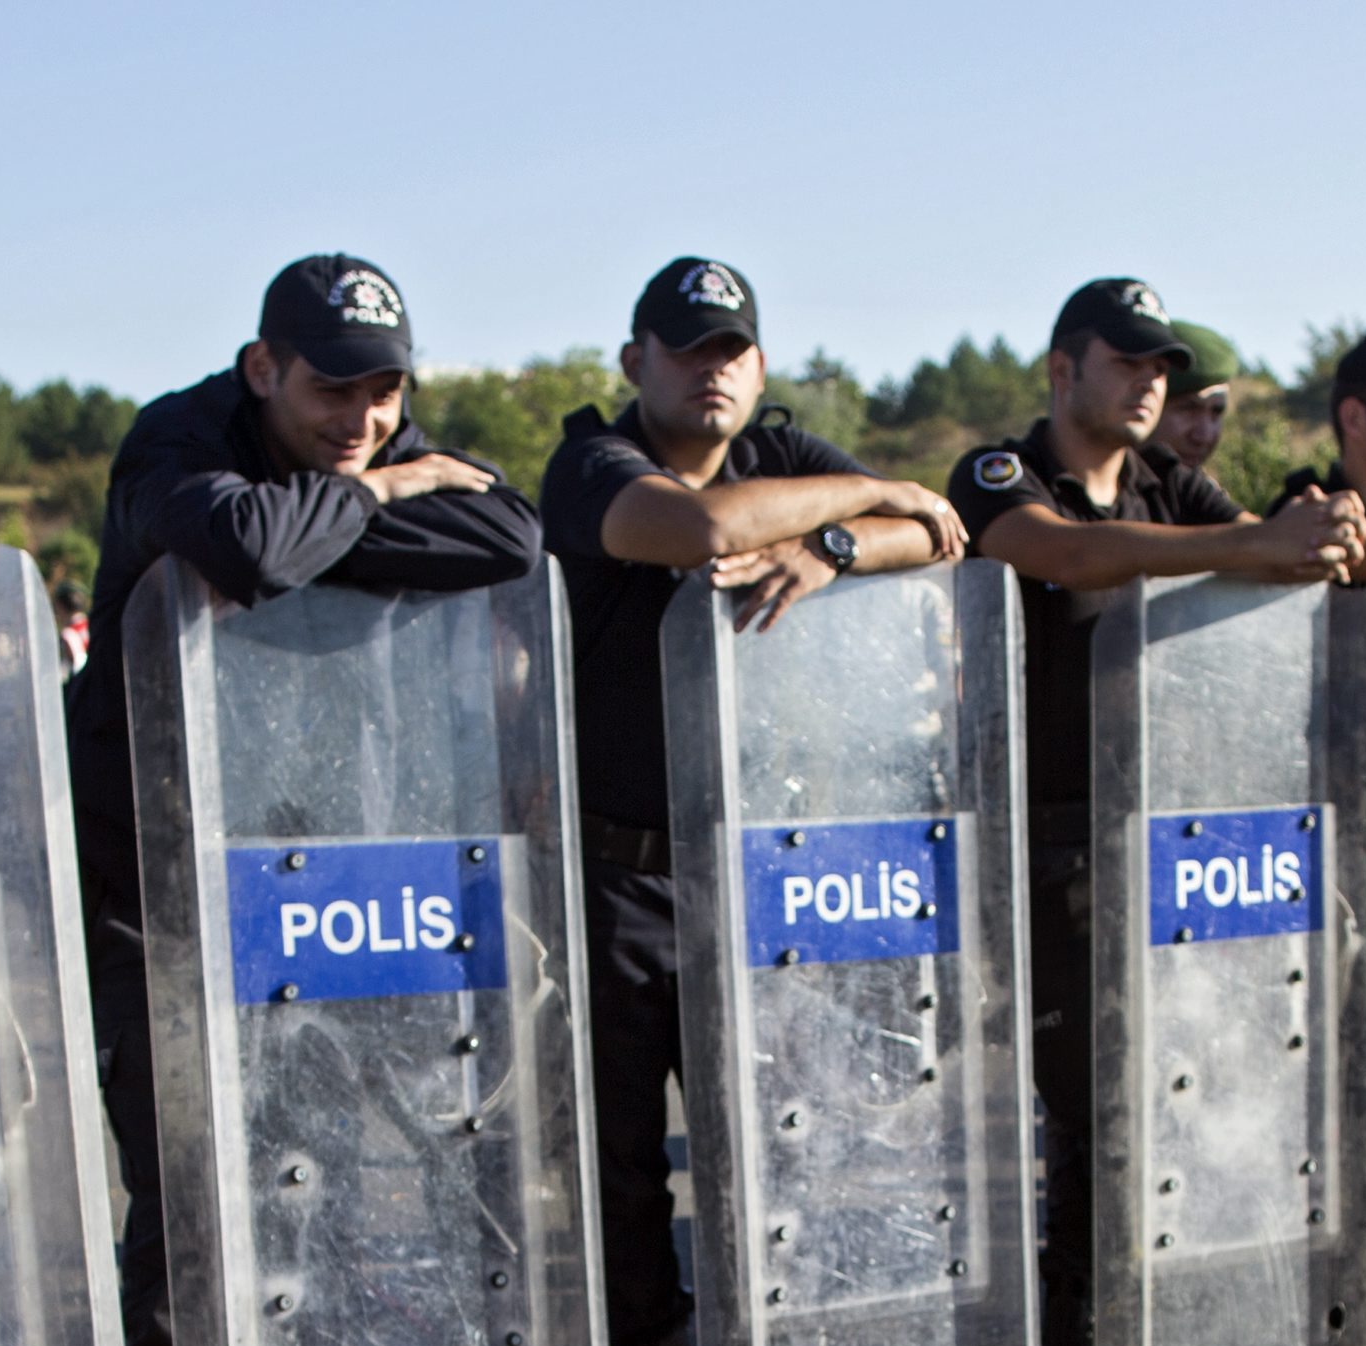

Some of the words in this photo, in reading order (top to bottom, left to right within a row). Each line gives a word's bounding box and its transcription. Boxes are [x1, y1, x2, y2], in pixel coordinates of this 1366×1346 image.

[783, 861, 922, 925] POLİS
[1175, 843, 1302, 910] POLİS
[280, 886, 456, 957] POLİS
